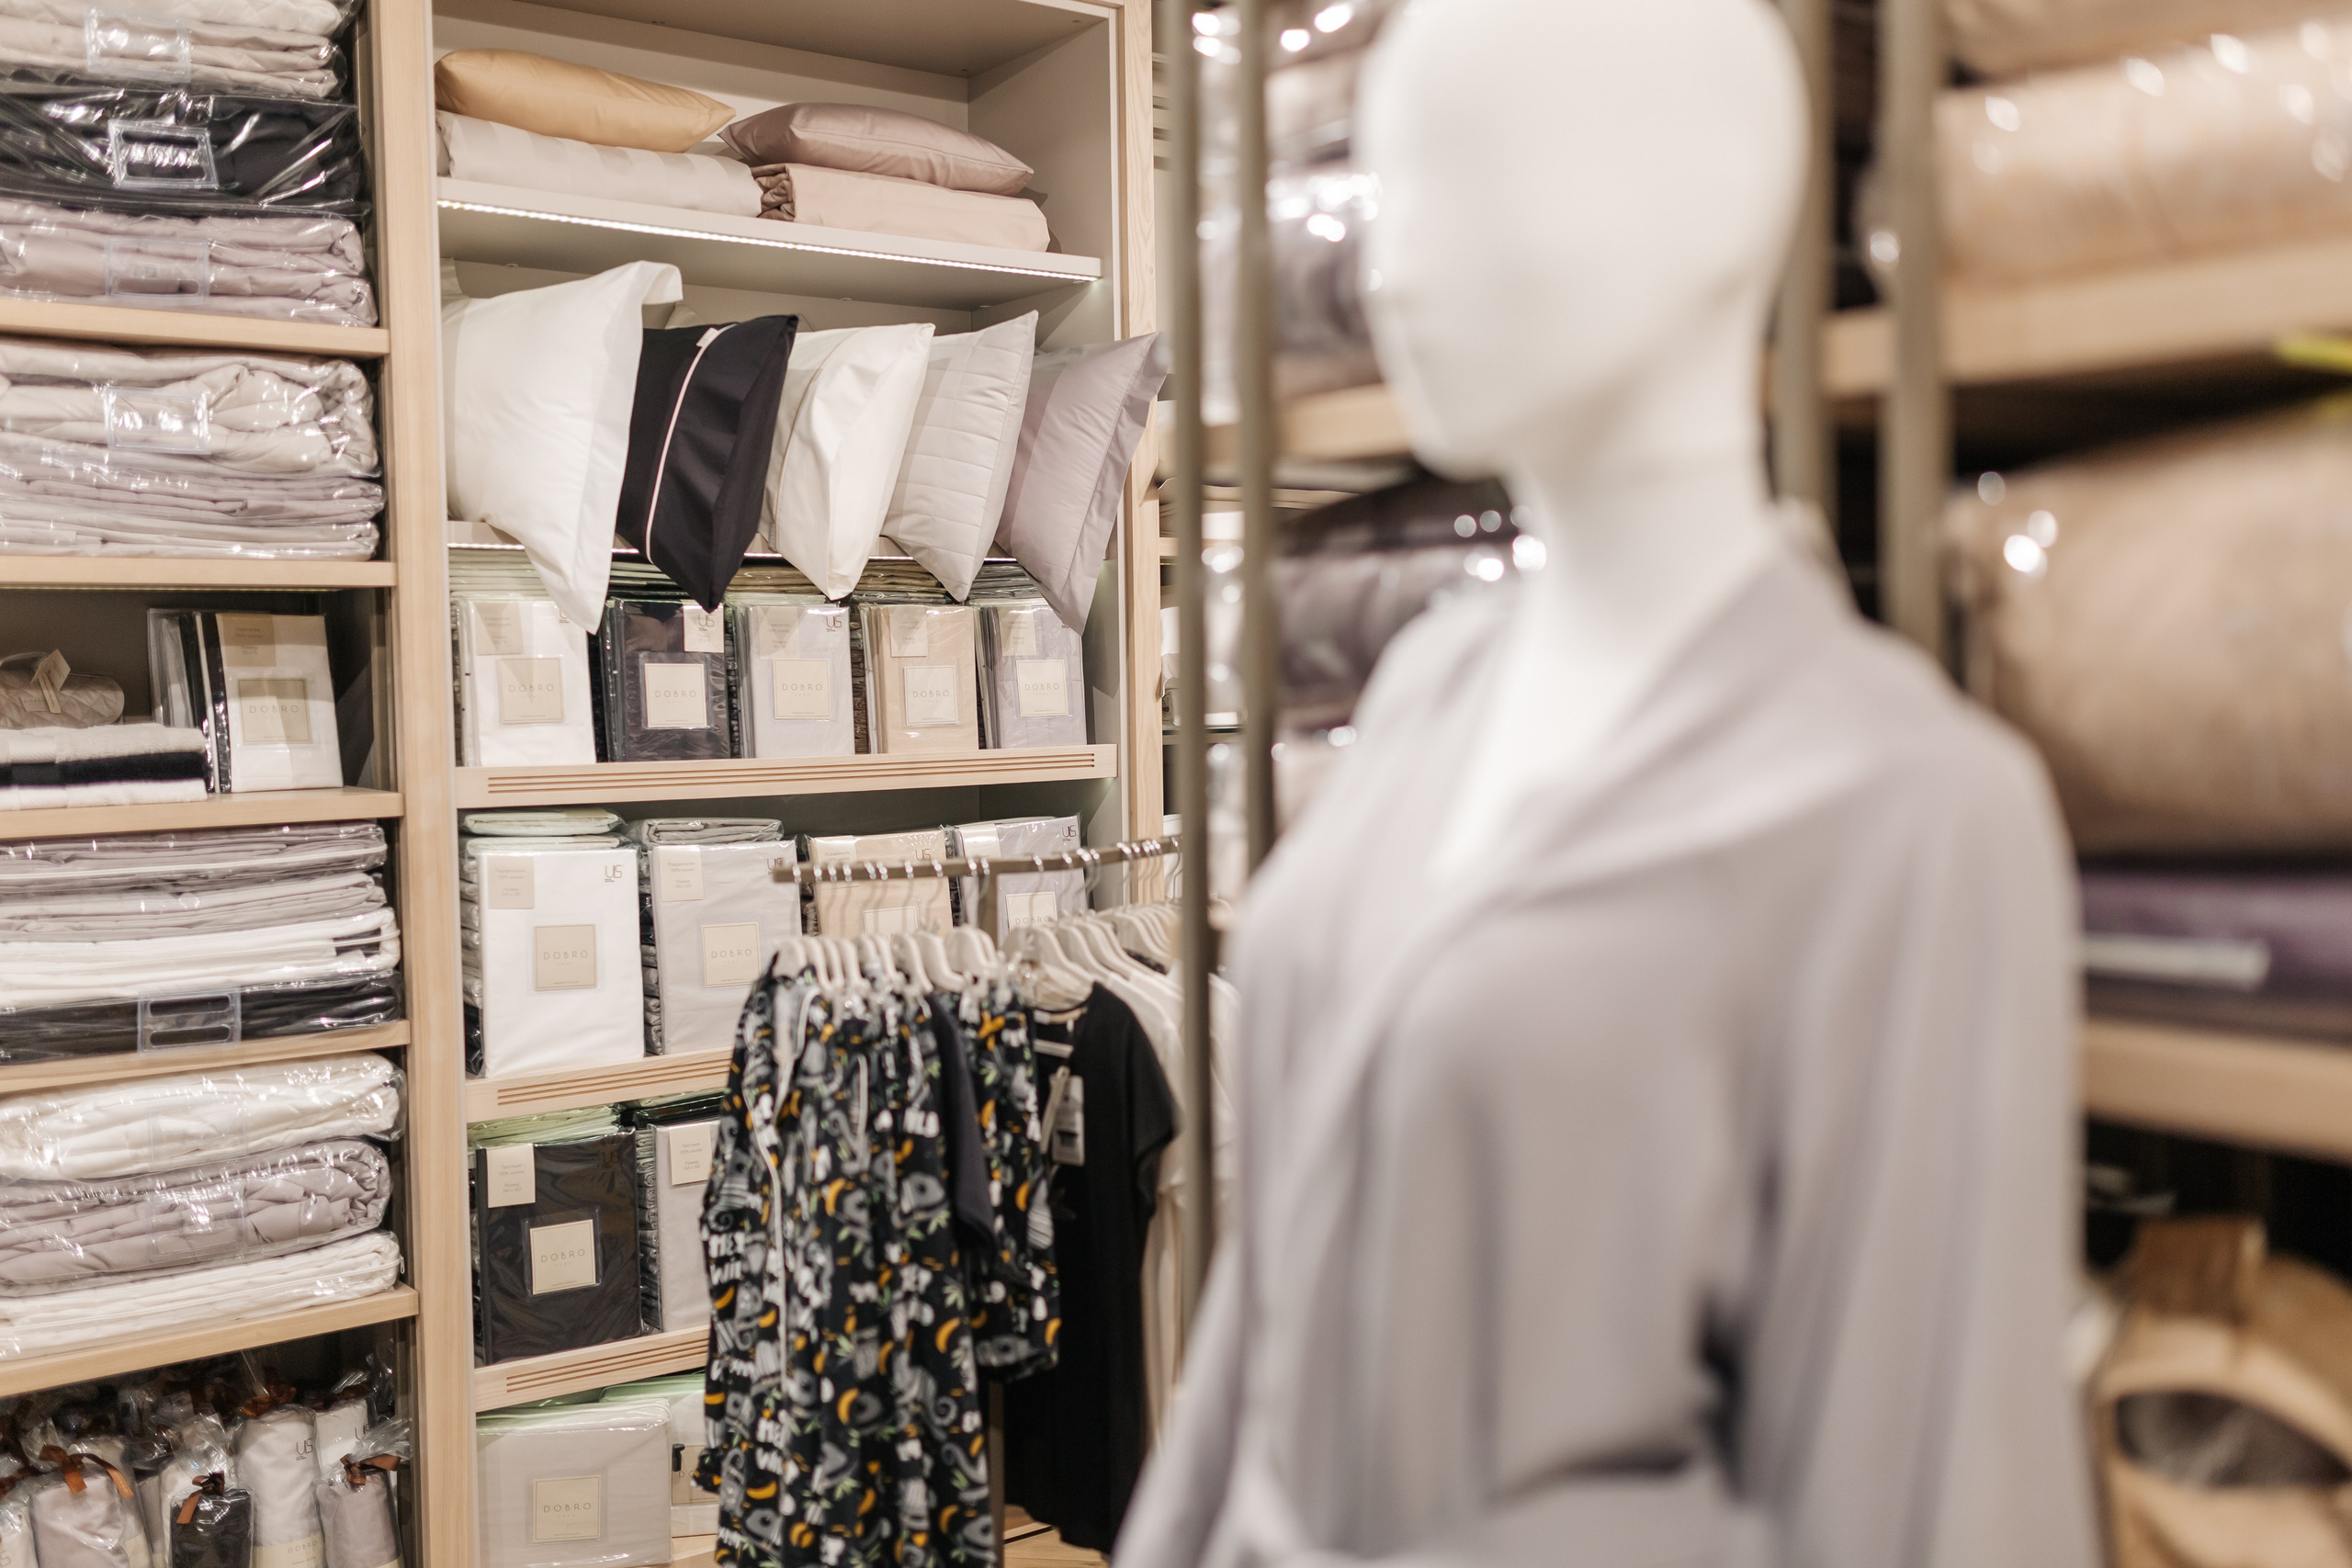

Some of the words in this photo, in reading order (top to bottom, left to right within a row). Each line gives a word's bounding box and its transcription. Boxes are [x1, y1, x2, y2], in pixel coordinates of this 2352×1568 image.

[508, 683, 554, 693] DOBRO
[1024, 682, 1059, 691] DOBRO
[654, 690, 697, 698] DOBRO
[912, 690, 949, 698] DOBRO
[249, 705, 300, 714] DOBRO
[543, 950, 588, 960] DOBRO
[711, 948, 752, 959] DOBRO
[540, 1248, 585, 1263] DOBRO
[543, 1502, 592, 1513] DOBRO
[288, 1539, 318, 1554] DOBRO
